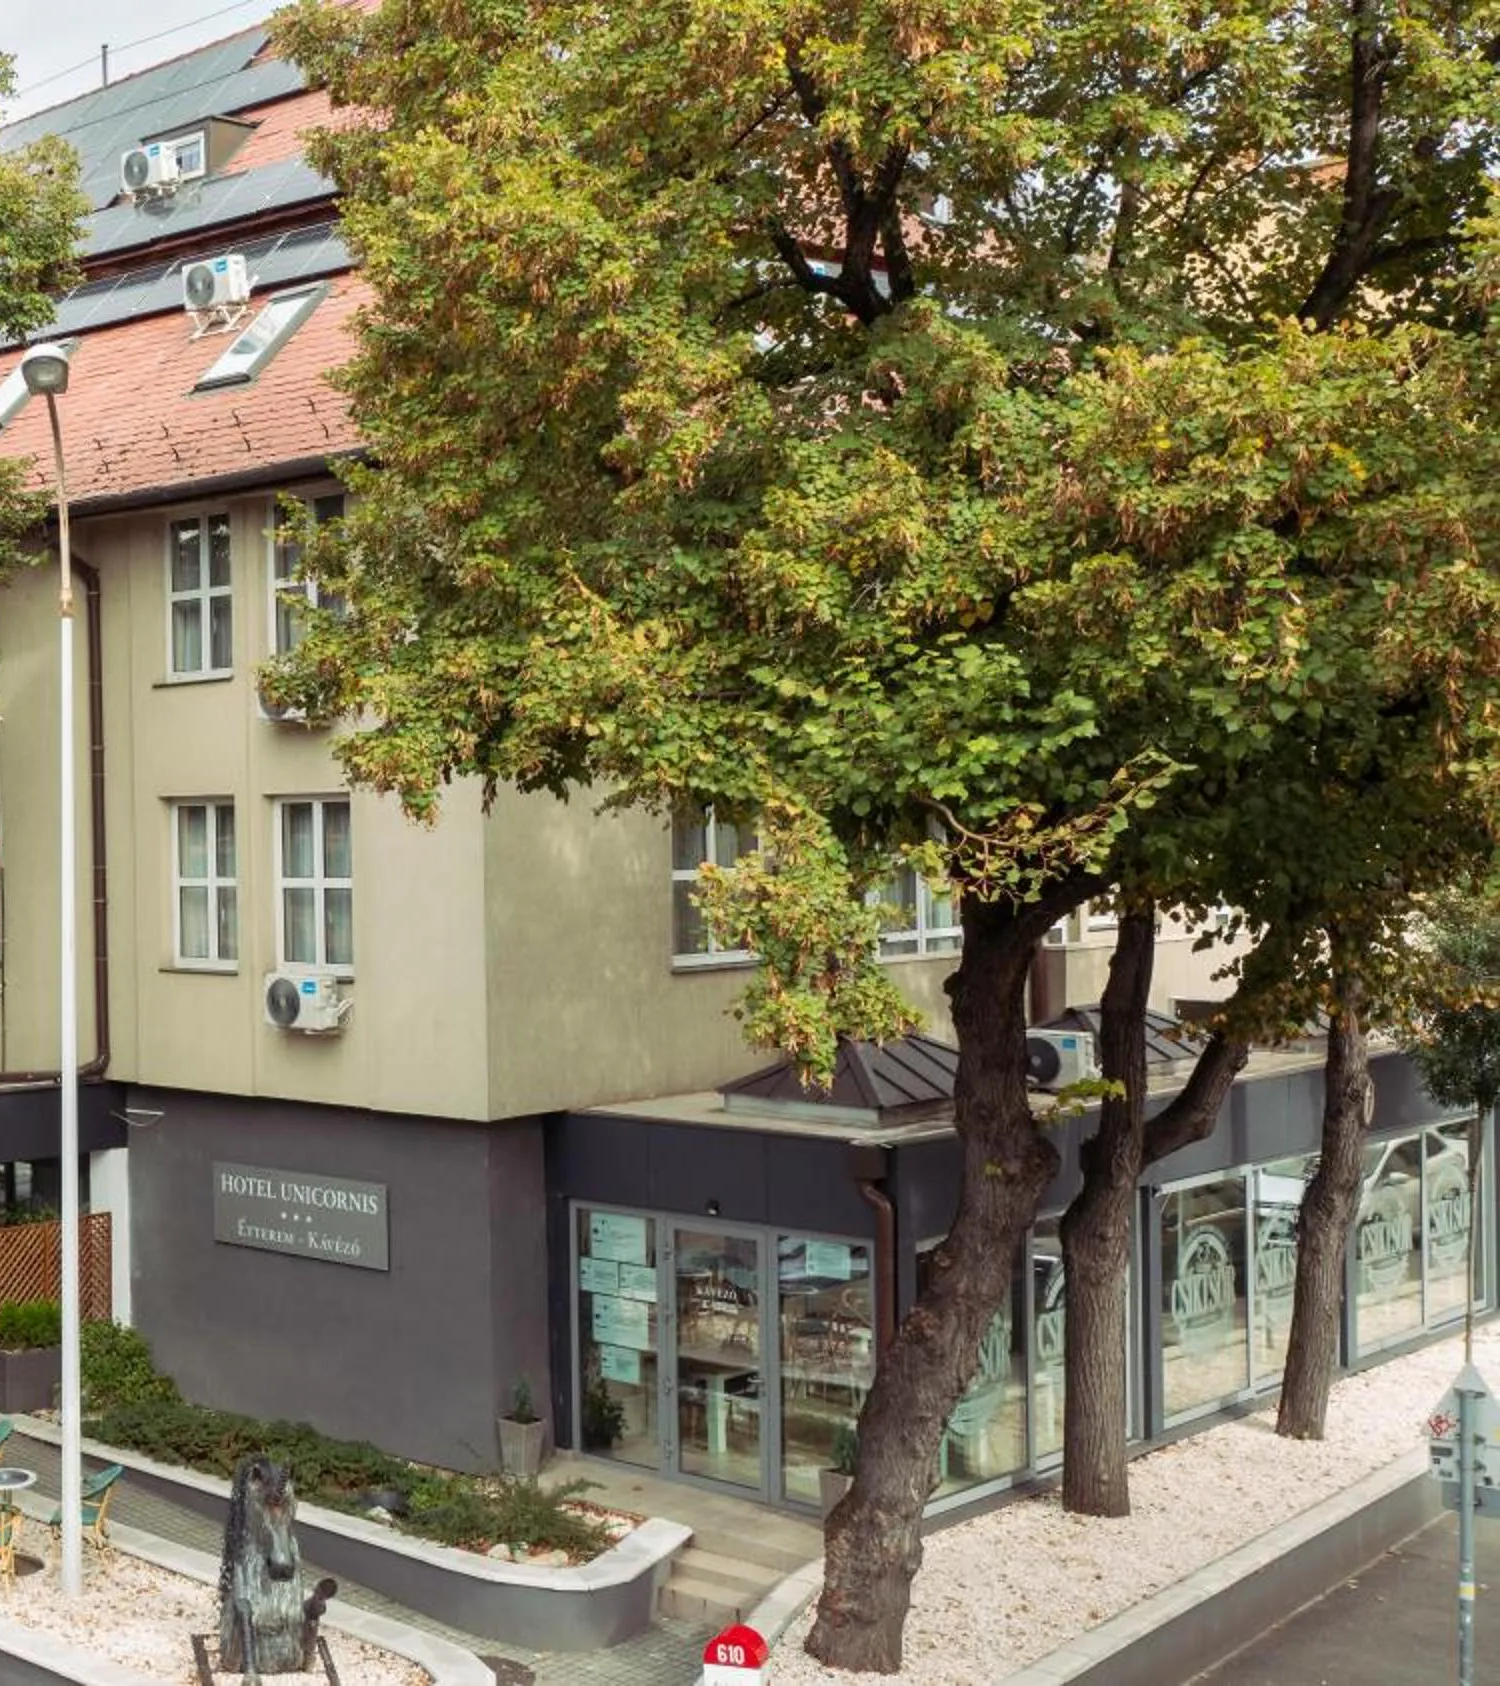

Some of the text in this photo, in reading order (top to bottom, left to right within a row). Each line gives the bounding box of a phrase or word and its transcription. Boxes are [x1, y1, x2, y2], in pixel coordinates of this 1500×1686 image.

[220, 1173, 379, 1215] HOTEL UNICORNIS
[717, 1643, 746, 1665] 610
